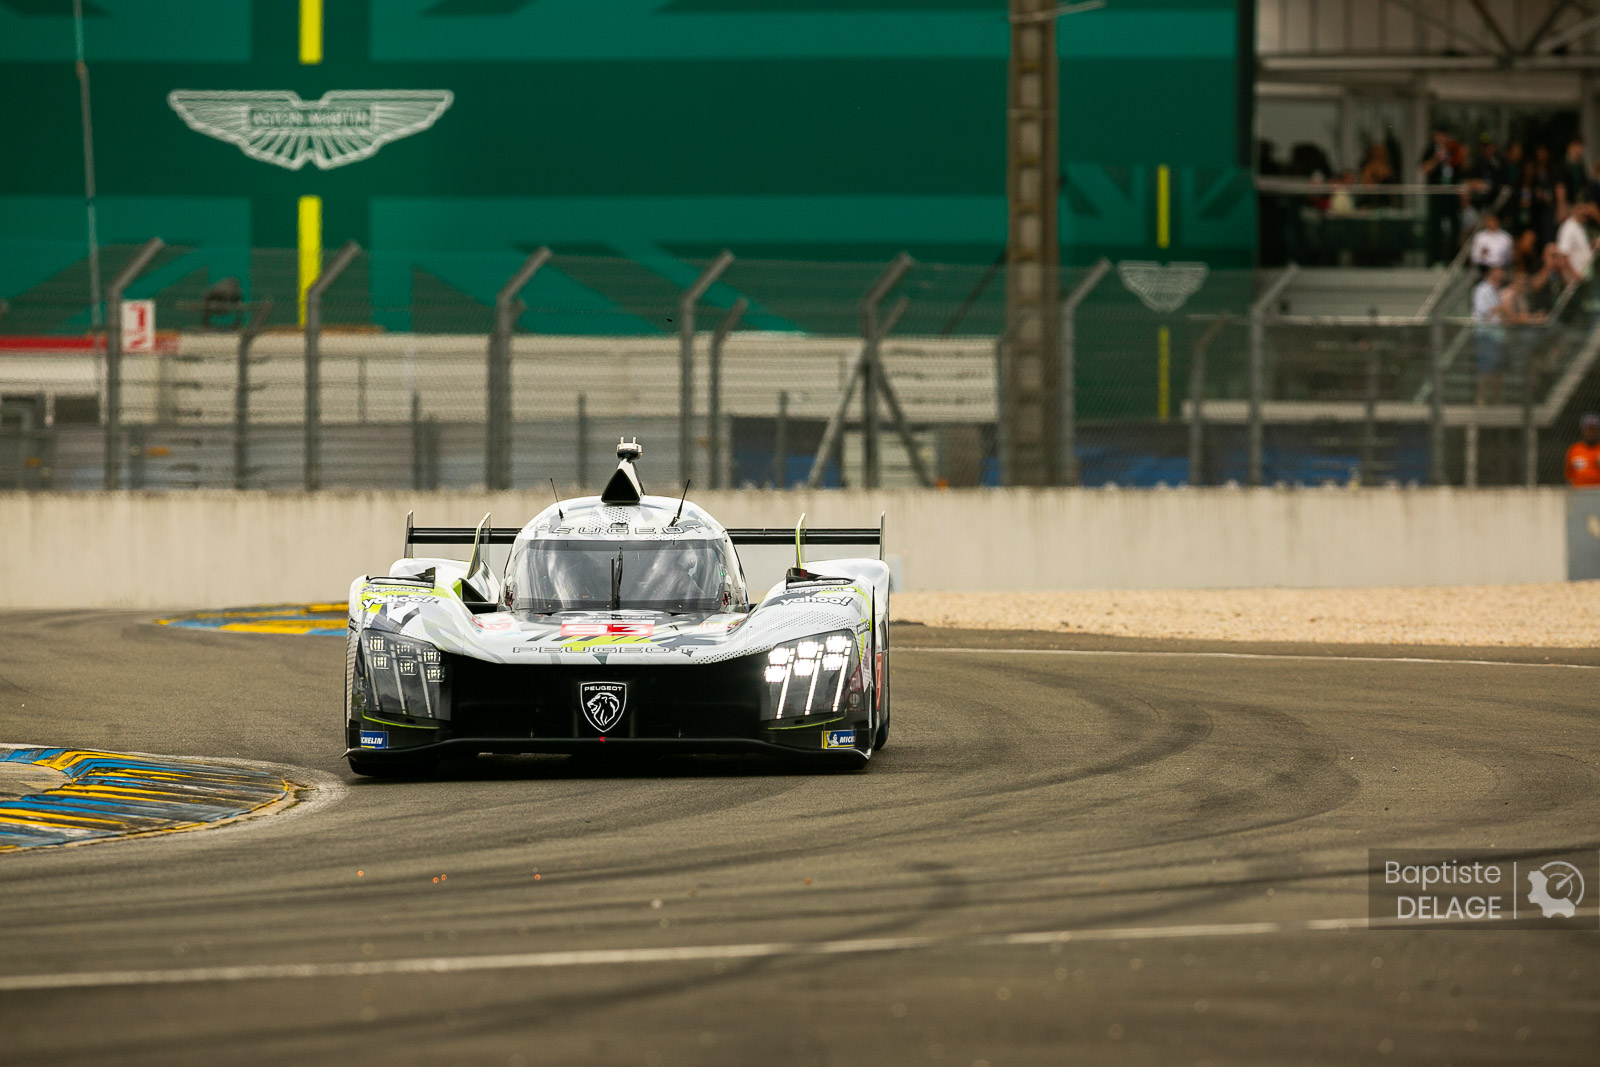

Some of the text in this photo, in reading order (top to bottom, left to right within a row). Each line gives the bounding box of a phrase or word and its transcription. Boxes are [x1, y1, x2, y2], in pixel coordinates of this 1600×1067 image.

[538, 524, 706, 534] PEUGEOT
[362, 594, 439, 609] yahoo!
[780, 595, 853, 606] yahoo!
[566, 624, 649, 635] 93
[512, 646, 698, 655] PEUGEOT
